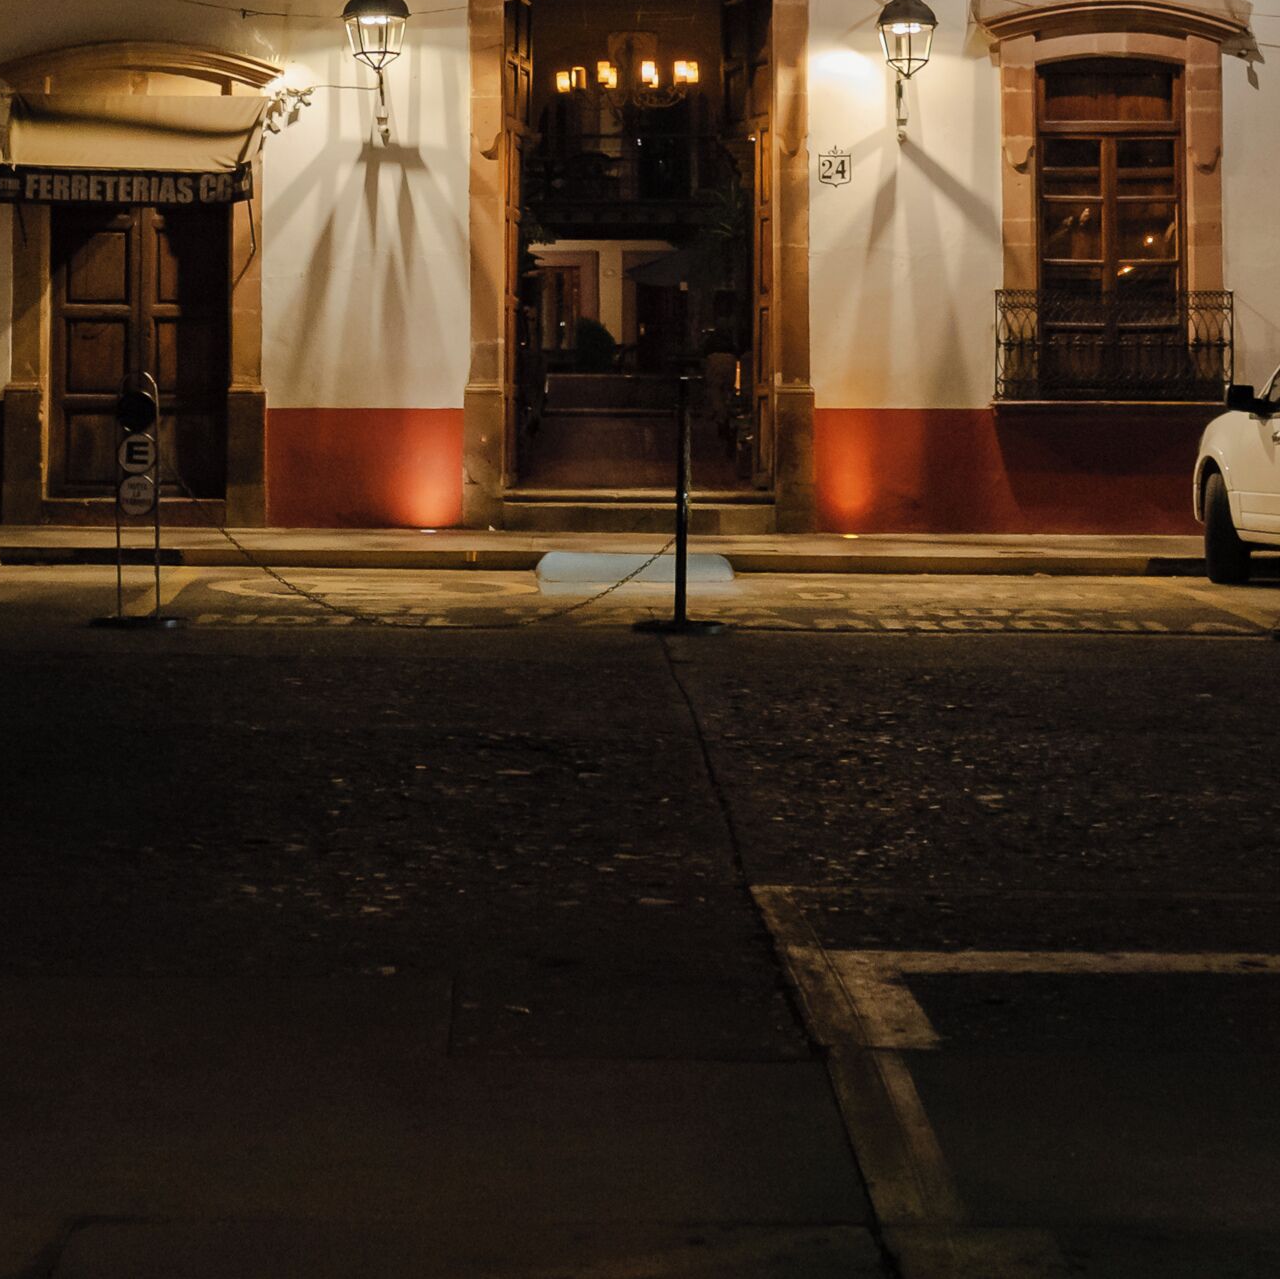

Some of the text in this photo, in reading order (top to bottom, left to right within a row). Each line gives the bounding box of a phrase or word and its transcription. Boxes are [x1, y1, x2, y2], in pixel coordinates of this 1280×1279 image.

[822, 160, 846, 179] 24
[25, 173, 194, 203] FERRETERIAS
[126, 441, 149, 464] E
